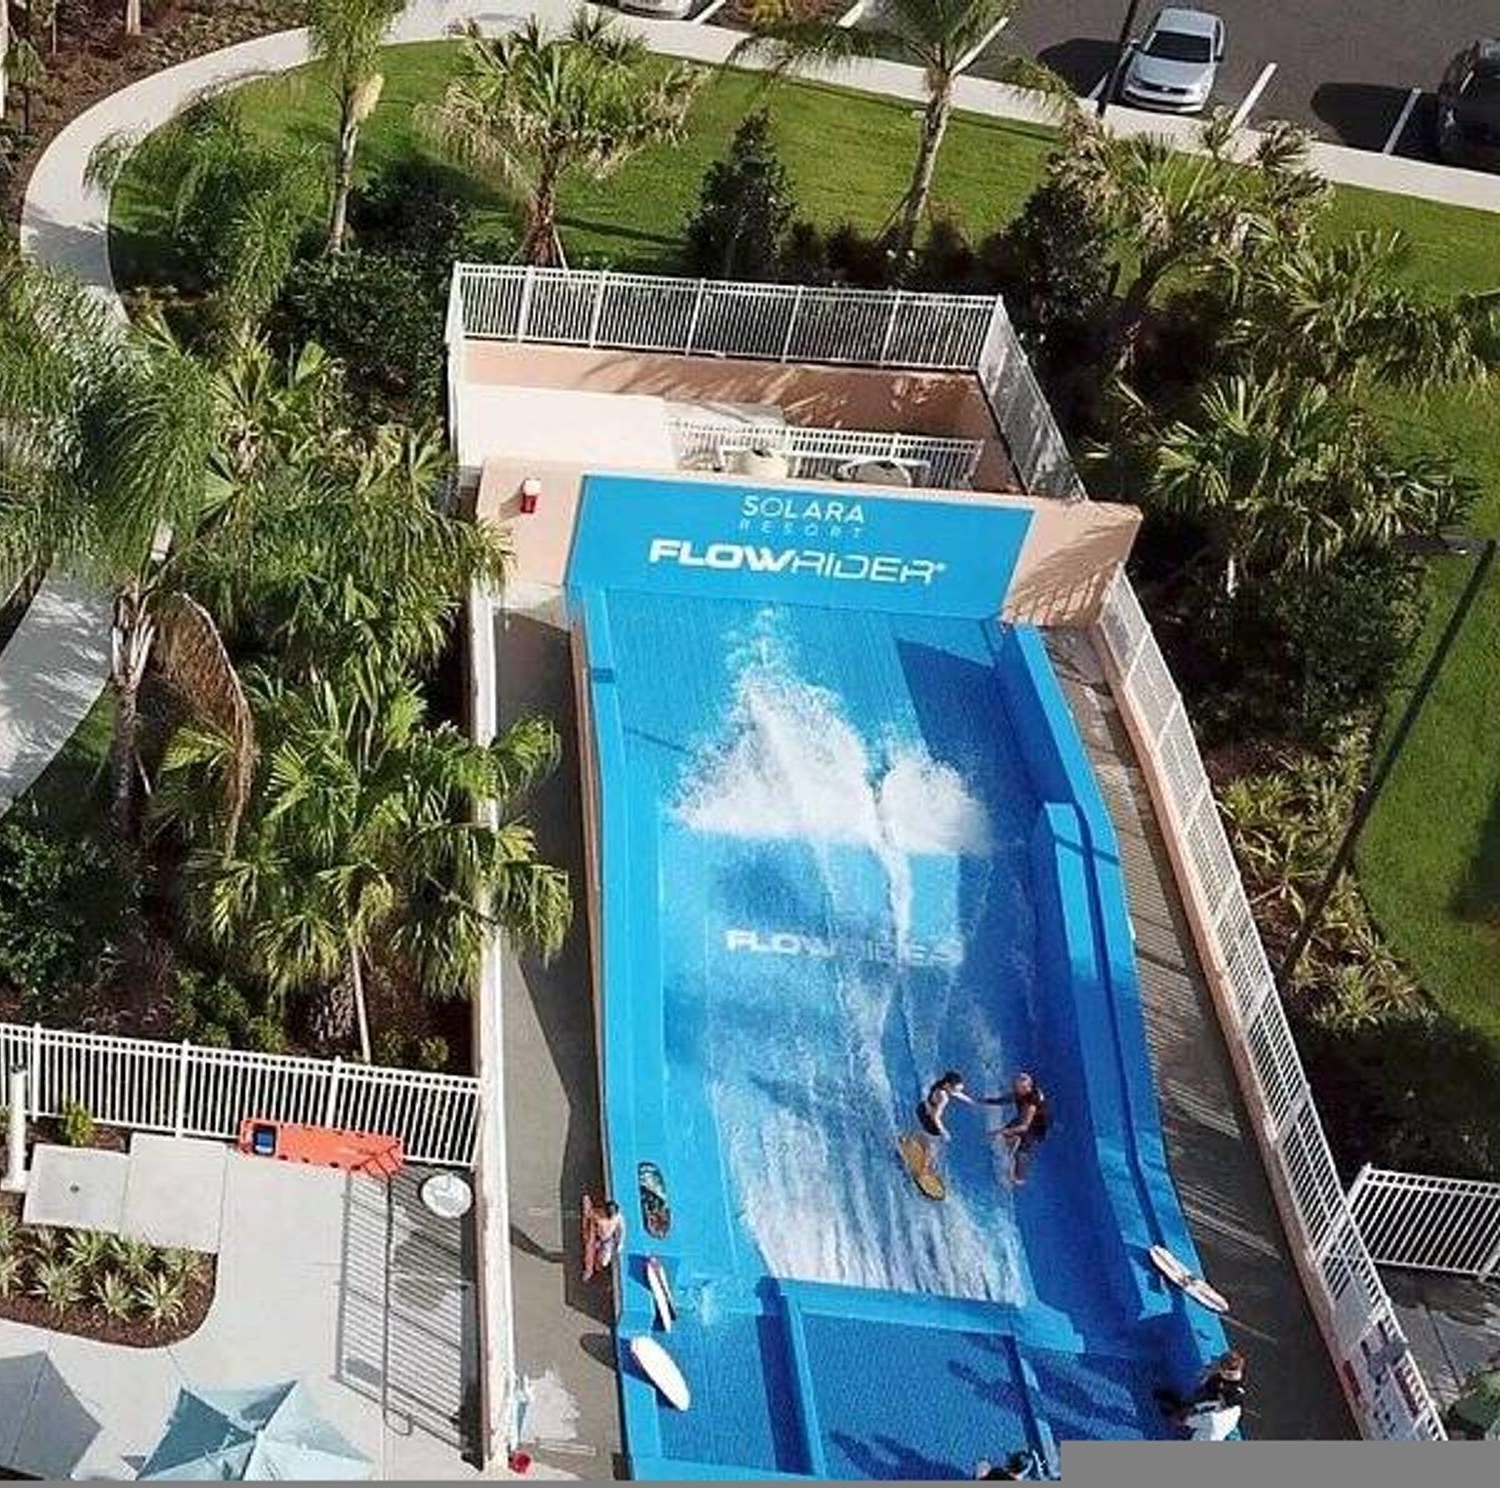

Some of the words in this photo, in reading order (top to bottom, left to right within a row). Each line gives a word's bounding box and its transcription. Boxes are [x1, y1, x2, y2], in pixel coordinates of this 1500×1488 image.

[742, 495, 864, 523] SOLARA
[740, 518, 862, 538] RESORT
[725, 929, 964, 967] FLOWIDE
